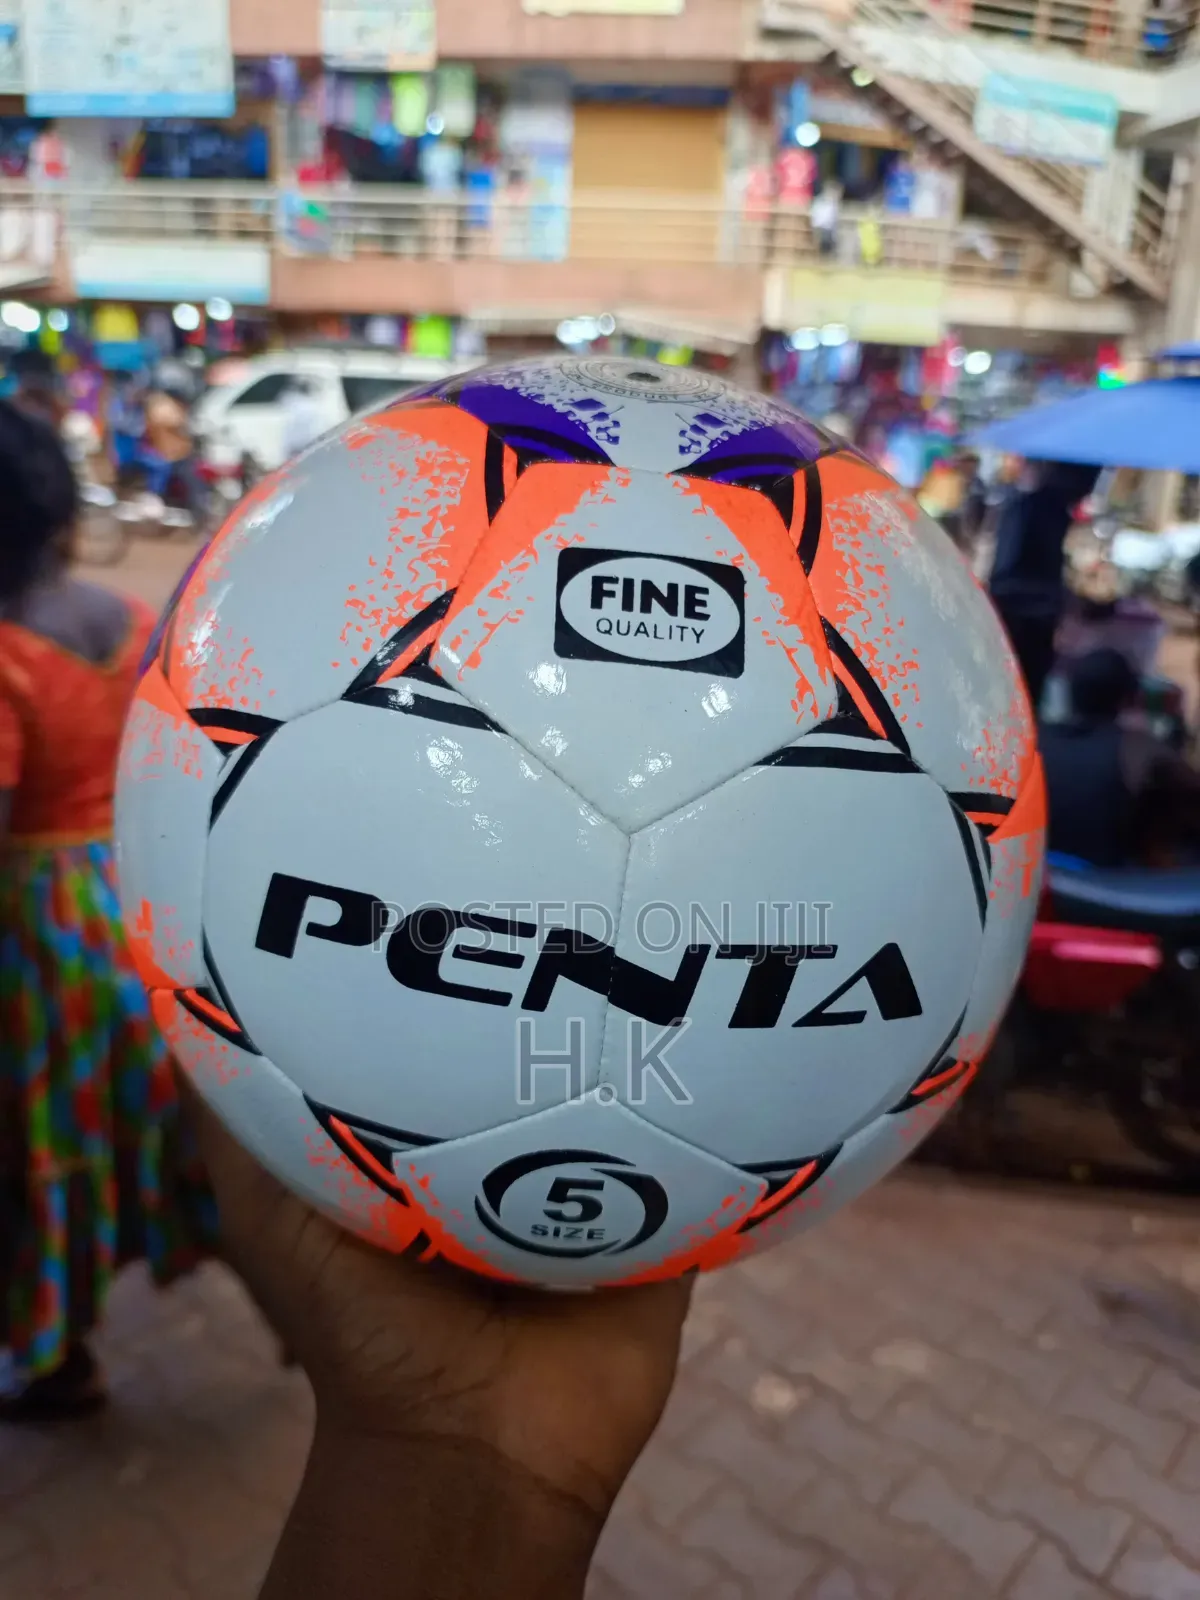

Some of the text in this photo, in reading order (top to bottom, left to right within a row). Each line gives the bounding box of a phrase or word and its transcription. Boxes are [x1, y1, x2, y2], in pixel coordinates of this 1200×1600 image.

[590, 575, 711, 621] FINE
[596, 617, 705, 644] QUALITY
[255, 872, 922, 1028] PENTA
[543, 1176, 605, 1223] 5
[530, 1223, 606, 1240] SIZE
